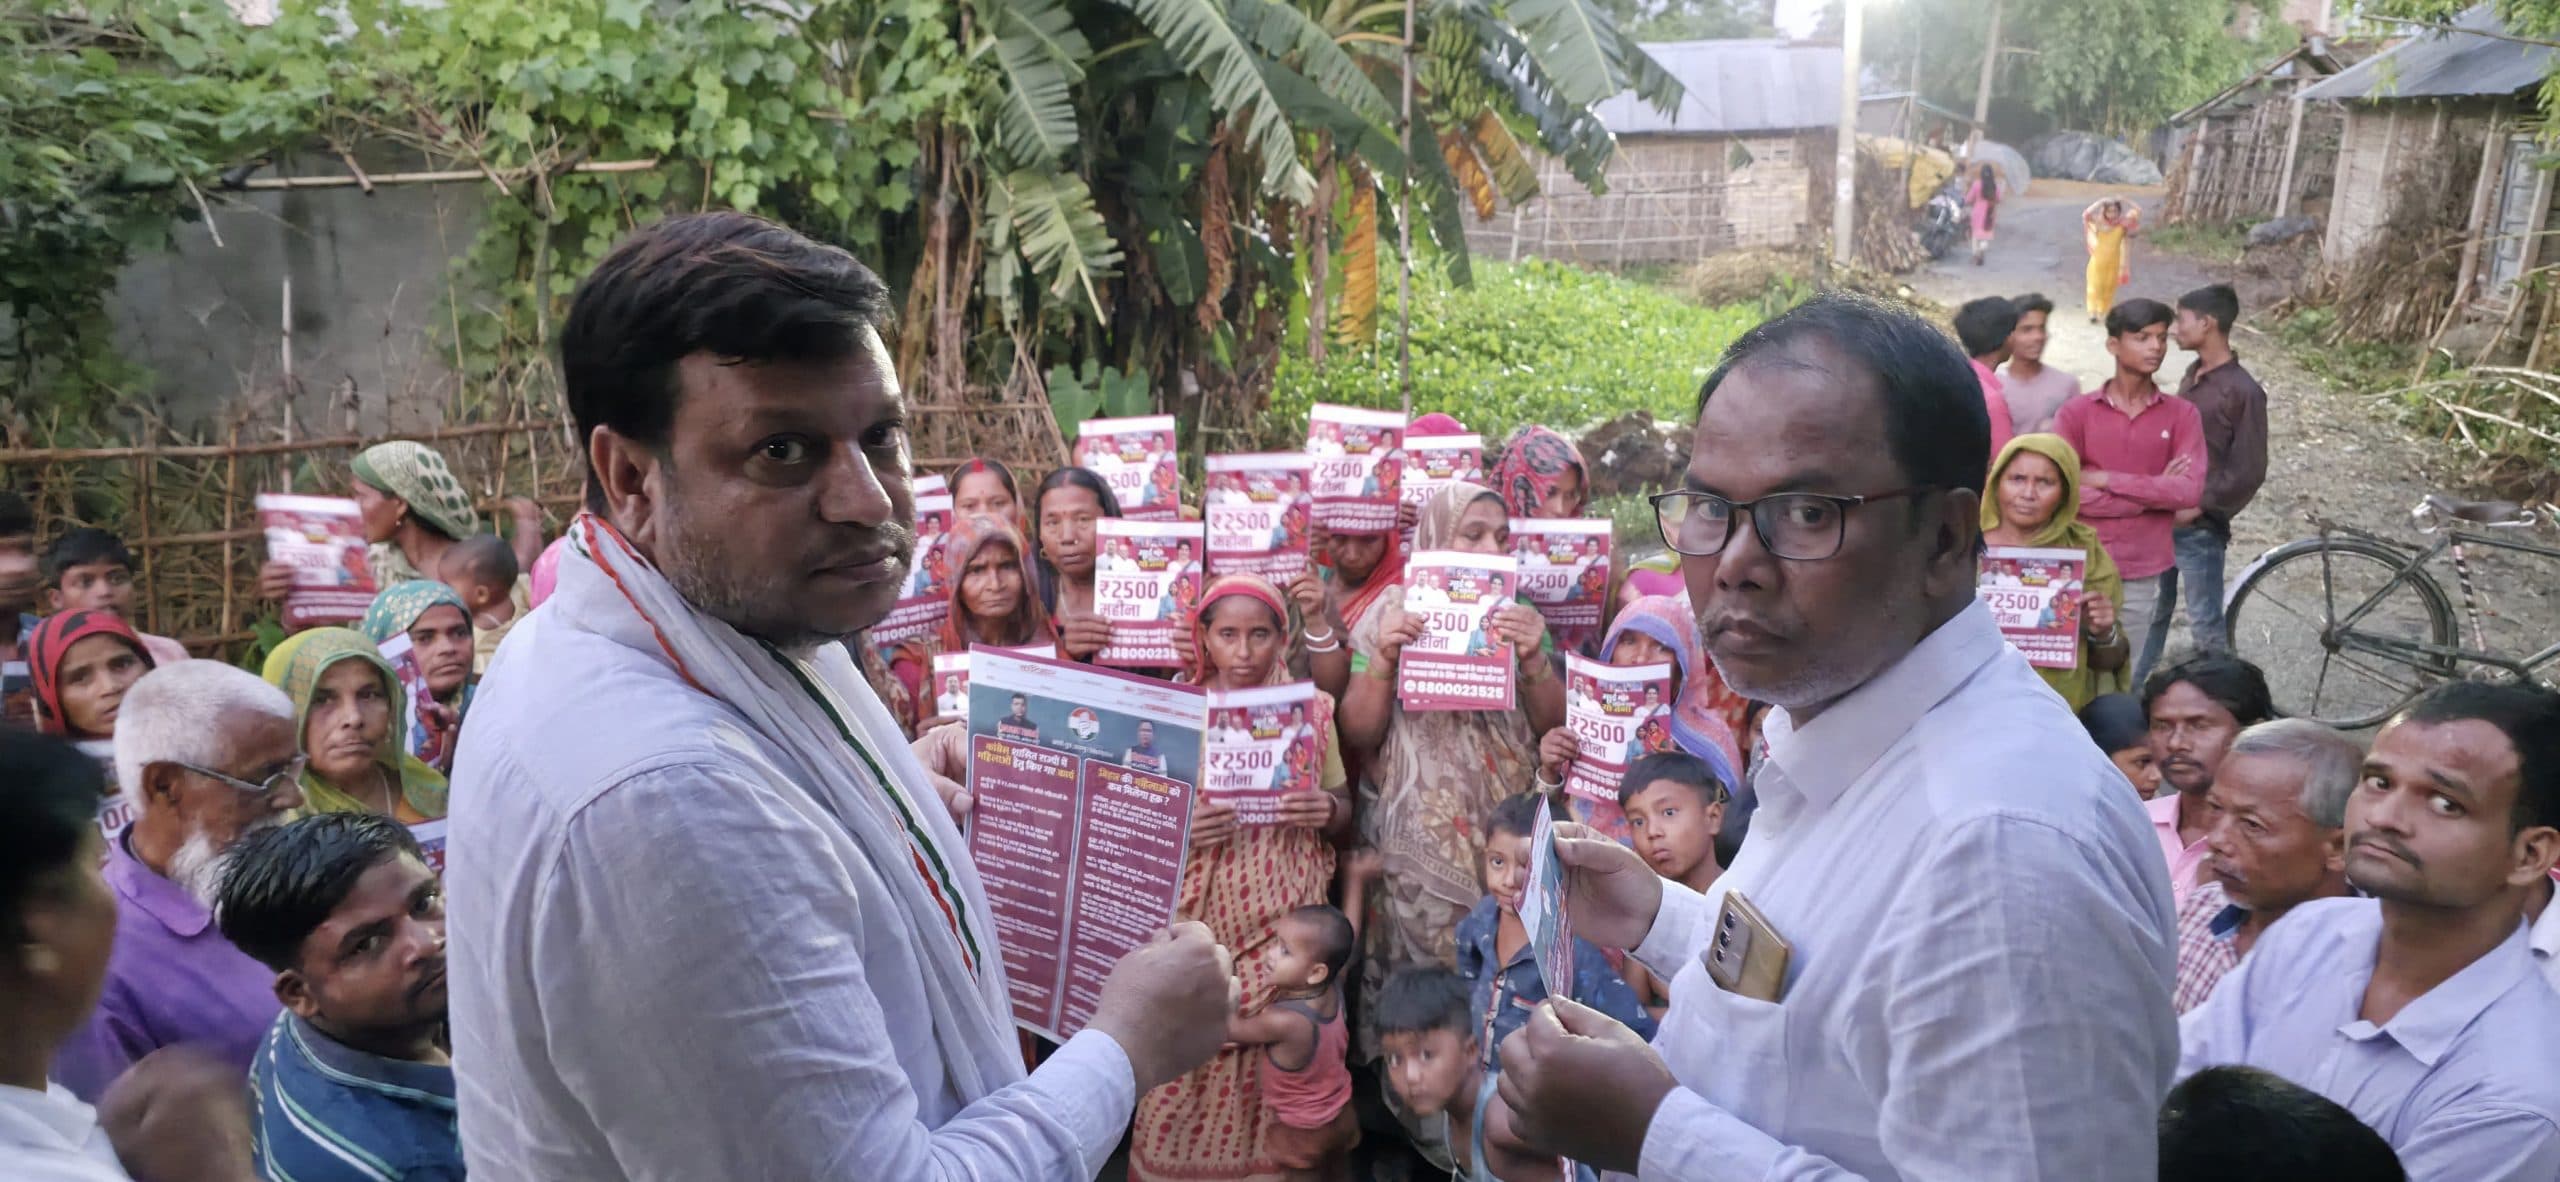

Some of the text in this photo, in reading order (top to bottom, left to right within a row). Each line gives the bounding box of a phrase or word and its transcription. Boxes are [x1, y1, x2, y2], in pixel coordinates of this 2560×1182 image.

[1110, 471, 1141, 489] 500
[1099, 579, 1159, 599] ₹2500
[1422, 611, 1469, 632] 2500
[1415, 630, 1449, 650] हीना
[1579, 736, 1607, 758] हीना
[1209, 750, 1273, 770] ₹2500
